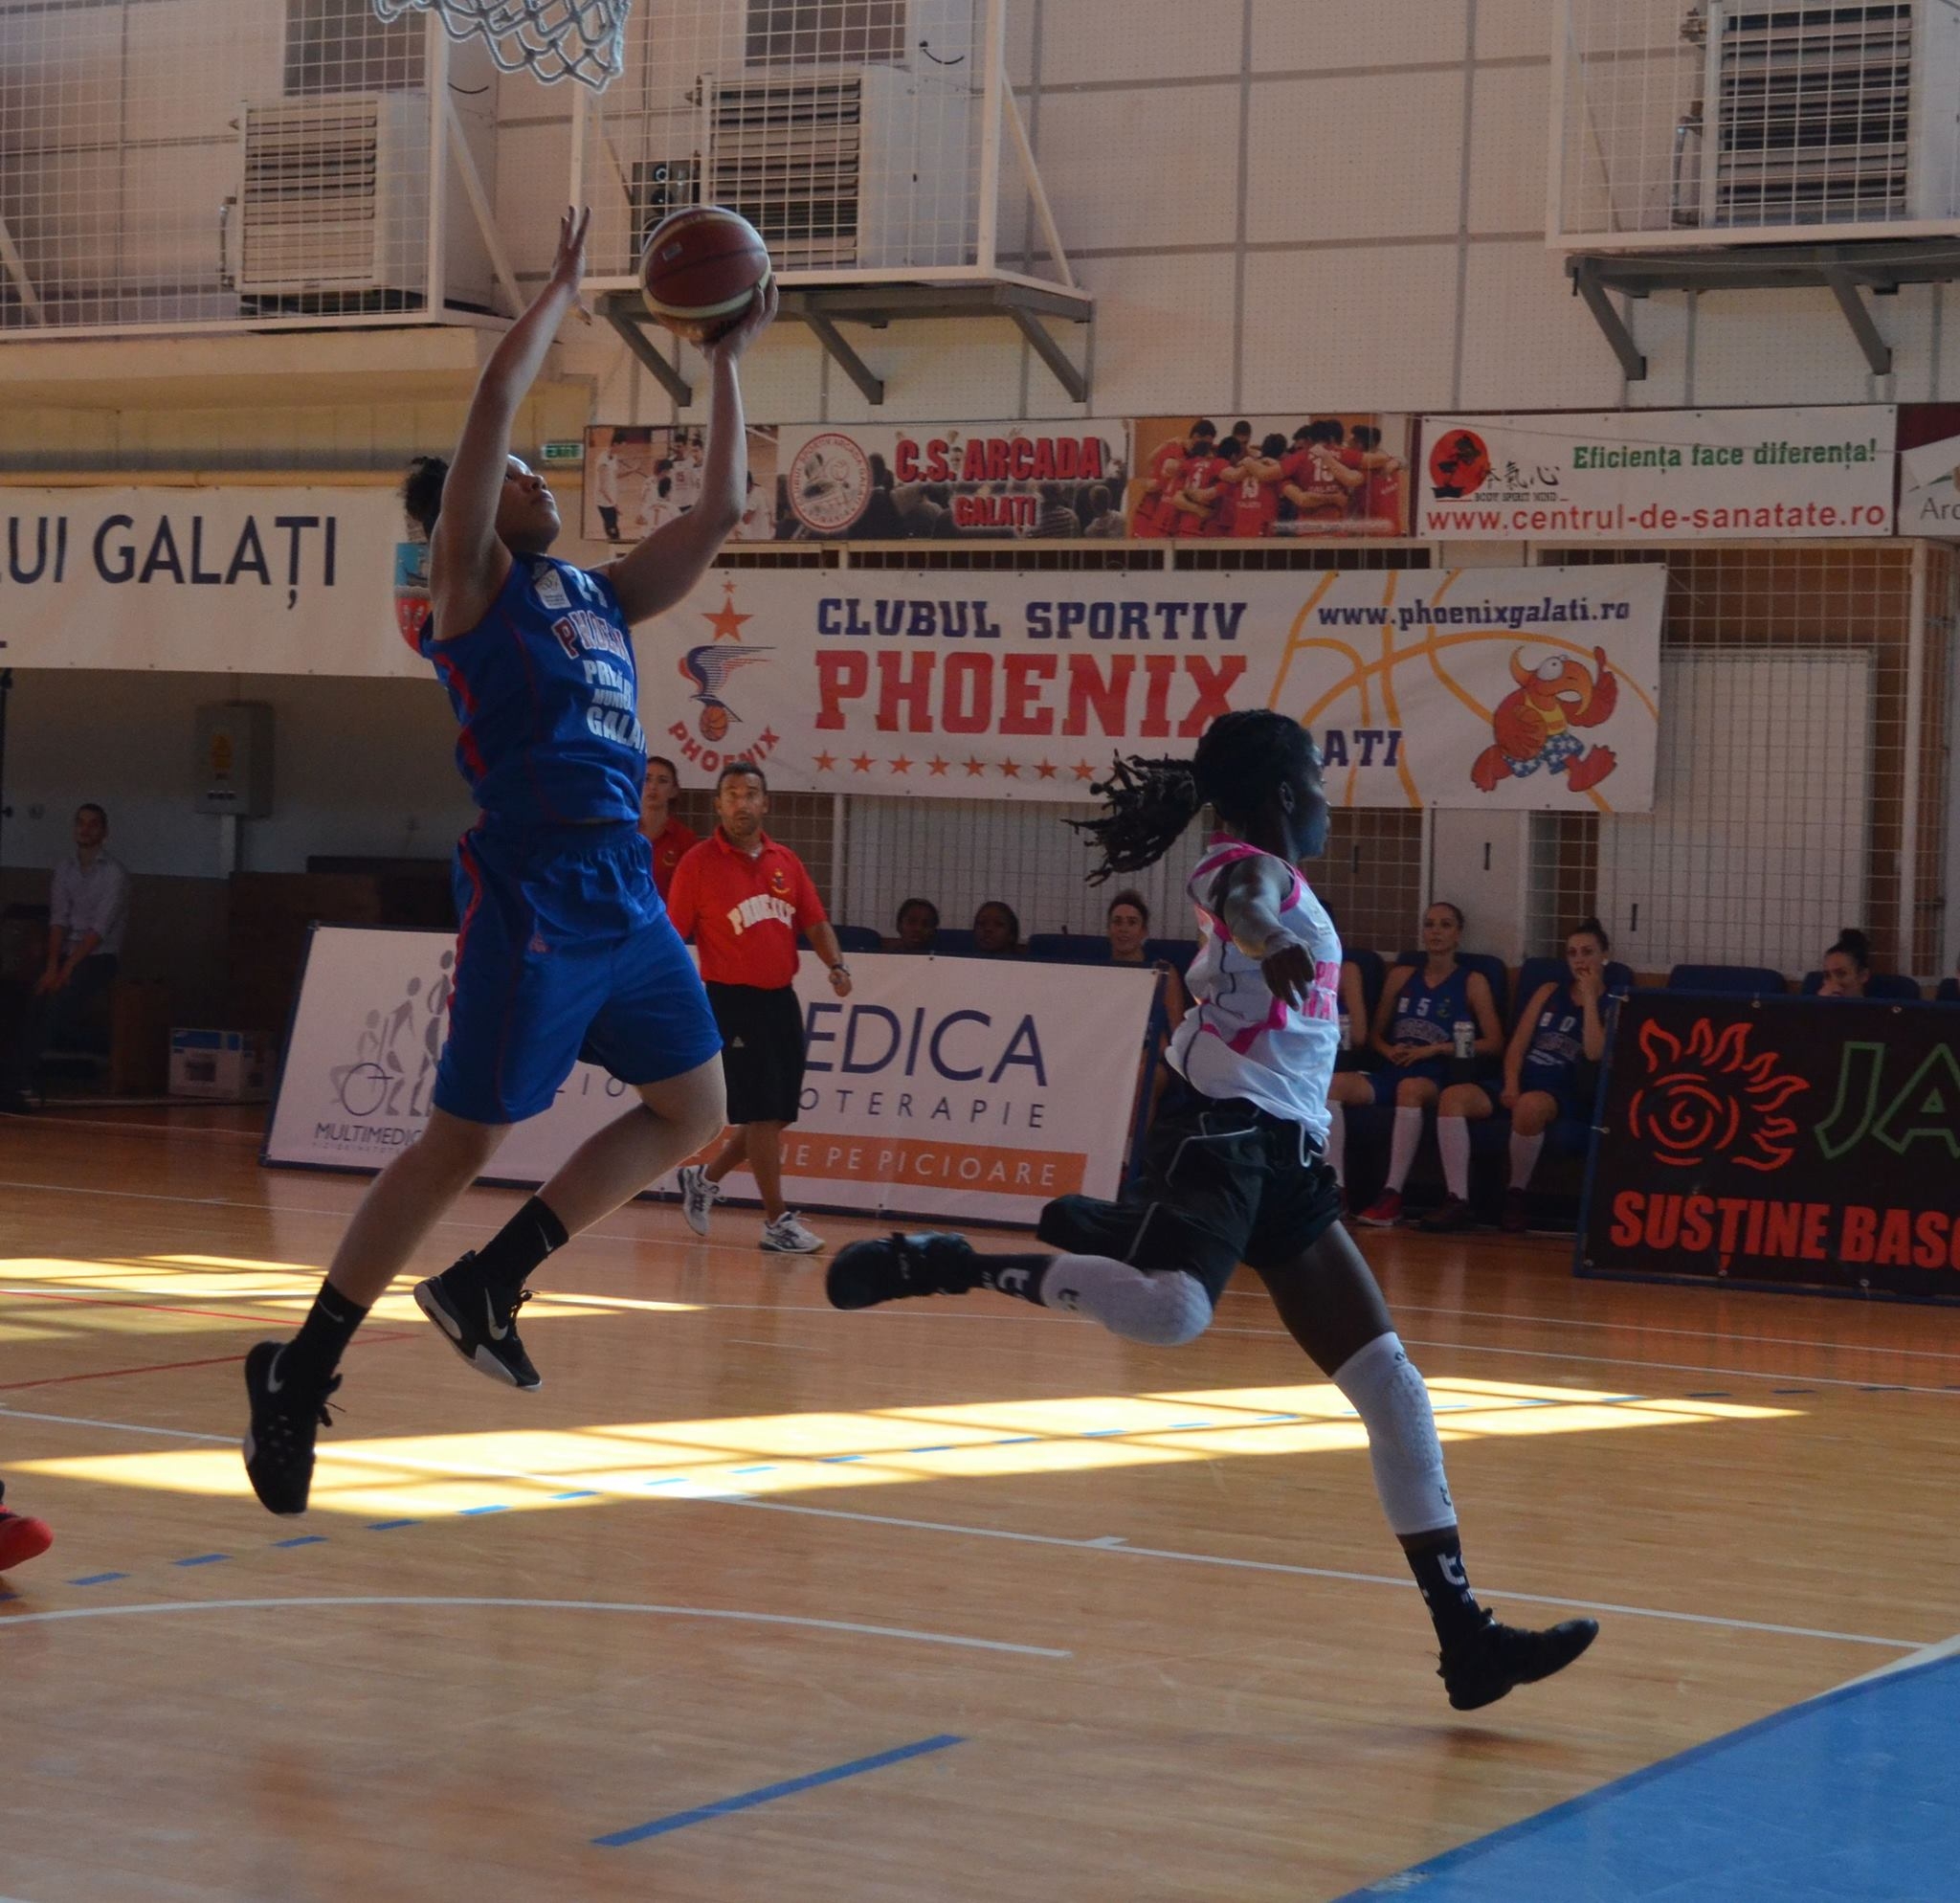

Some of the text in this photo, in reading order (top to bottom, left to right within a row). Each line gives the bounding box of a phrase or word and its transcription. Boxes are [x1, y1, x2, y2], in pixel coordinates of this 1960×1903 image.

[895, 437, 1103, 482] C.S. ARCADA
[1573, 438, 1876, 475] Eficiența face diferența!
[1426, 503, 1885, 531] www.centrul-de-sanatate.ro
[0, 513, 337, 610] UI GALAȚI
[817, 598, 1246, 639] CLUBUL SPORTIV
[1318, 597, 1631, 631] www.phoenixgalati.ro
[815, 650, 1247, 739] PHOENIX
[667, 721, 781, 772] PHOENIX
[1323, 729, 1402, 768] ATI
[804, 1001, 1048, 1087] EDICA
[798, 1086, 1045, 1129] OTERAPIE
[314, 1122, 422, 1146] MULTIMEDIC
[826, 1147, 862, 1170] PE
[878, 1151, 1056, 1187] PICIOARE
[1610, 1191, 1831, 1271] SUSȚINE
